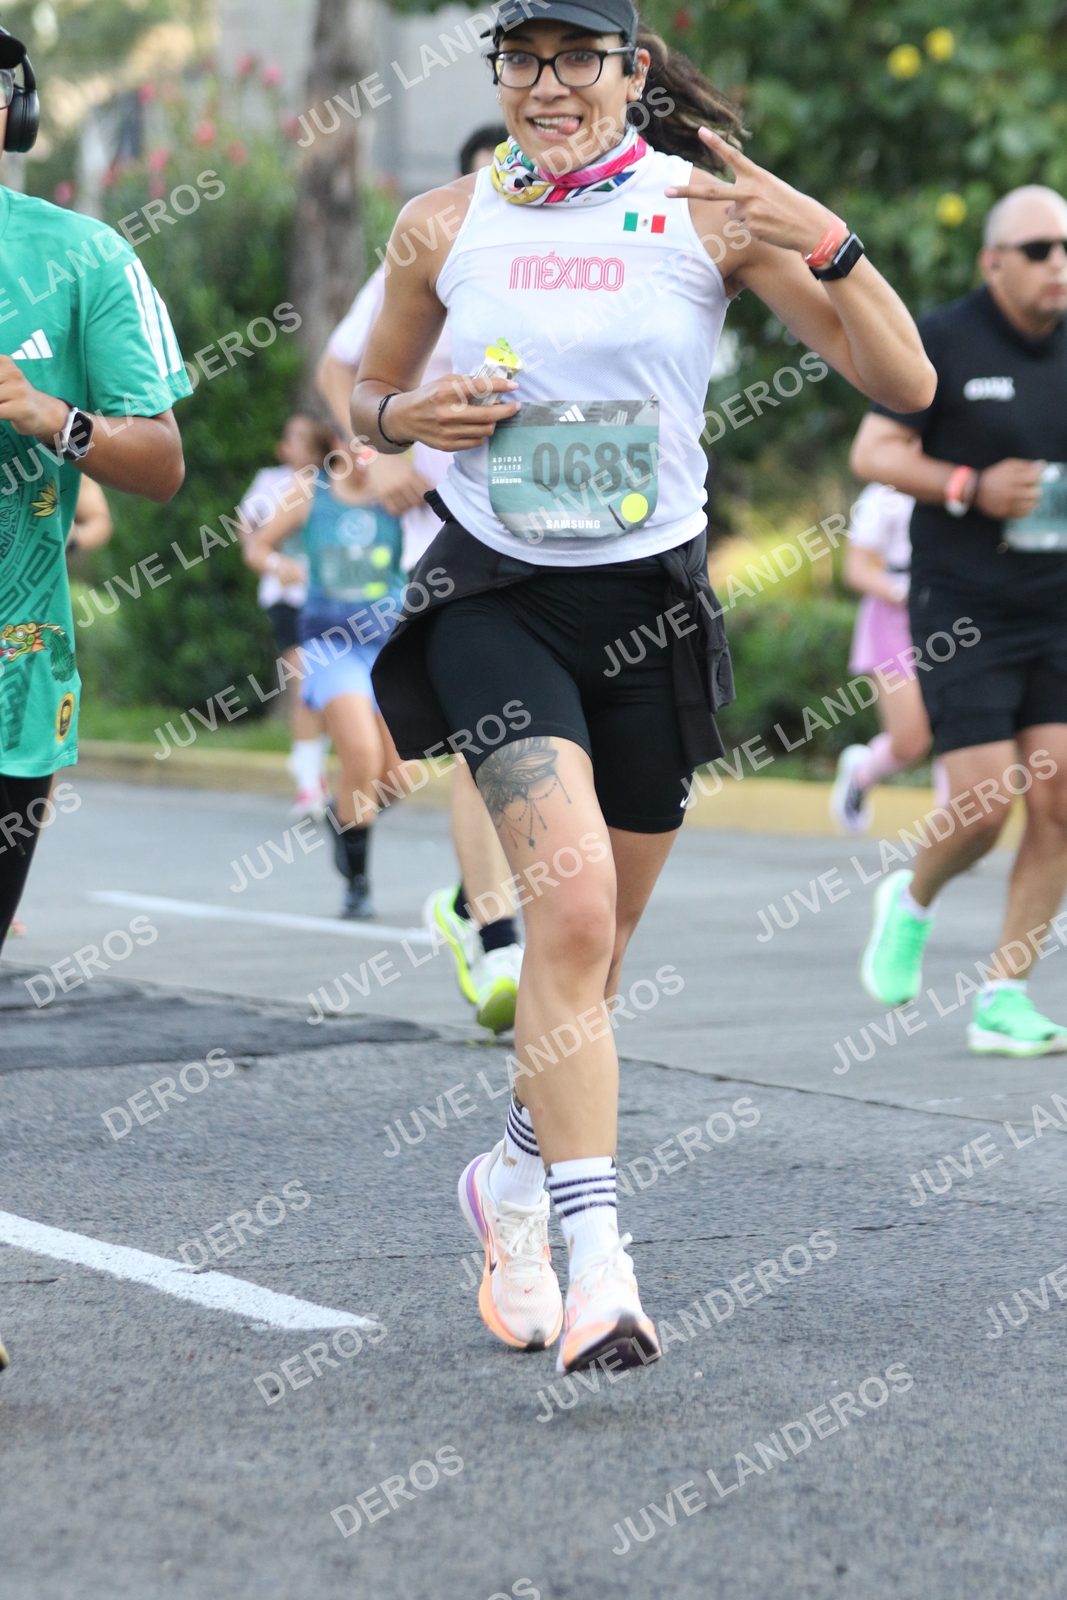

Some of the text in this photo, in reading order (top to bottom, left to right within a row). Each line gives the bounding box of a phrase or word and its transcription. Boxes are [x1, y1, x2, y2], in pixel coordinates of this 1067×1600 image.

[509, 250, 625, 291] MÉXICO
[532, 442, 653, 492] 0685
[546, 519, 600, 529] SAMSUNG
